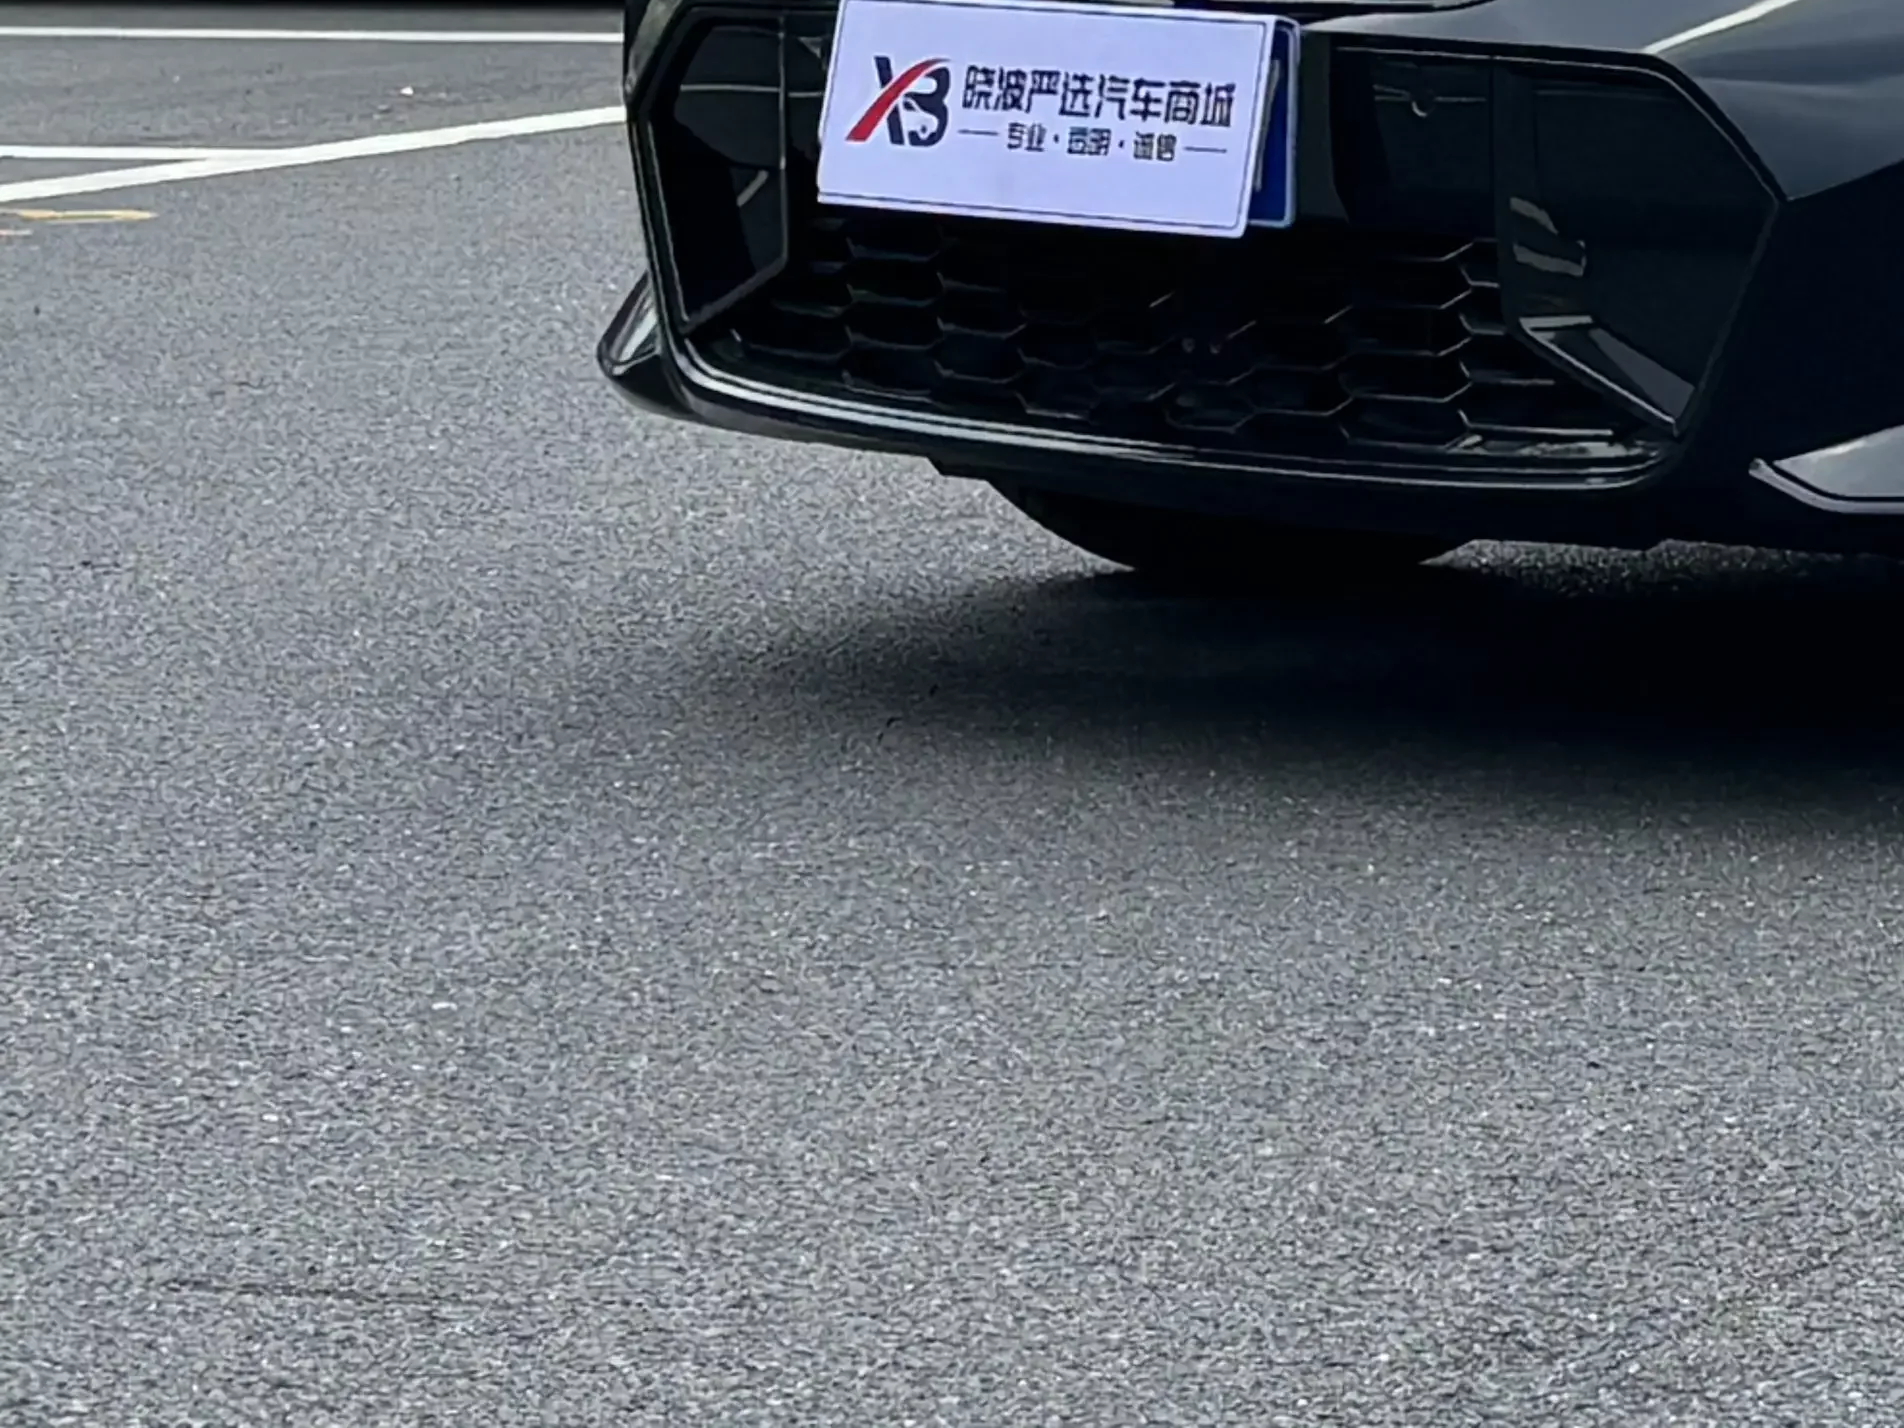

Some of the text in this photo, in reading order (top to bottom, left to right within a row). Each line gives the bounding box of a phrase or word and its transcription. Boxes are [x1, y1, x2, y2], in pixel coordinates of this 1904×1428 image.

[961, 64, 1236, 128] 晓波严选汽车商城
